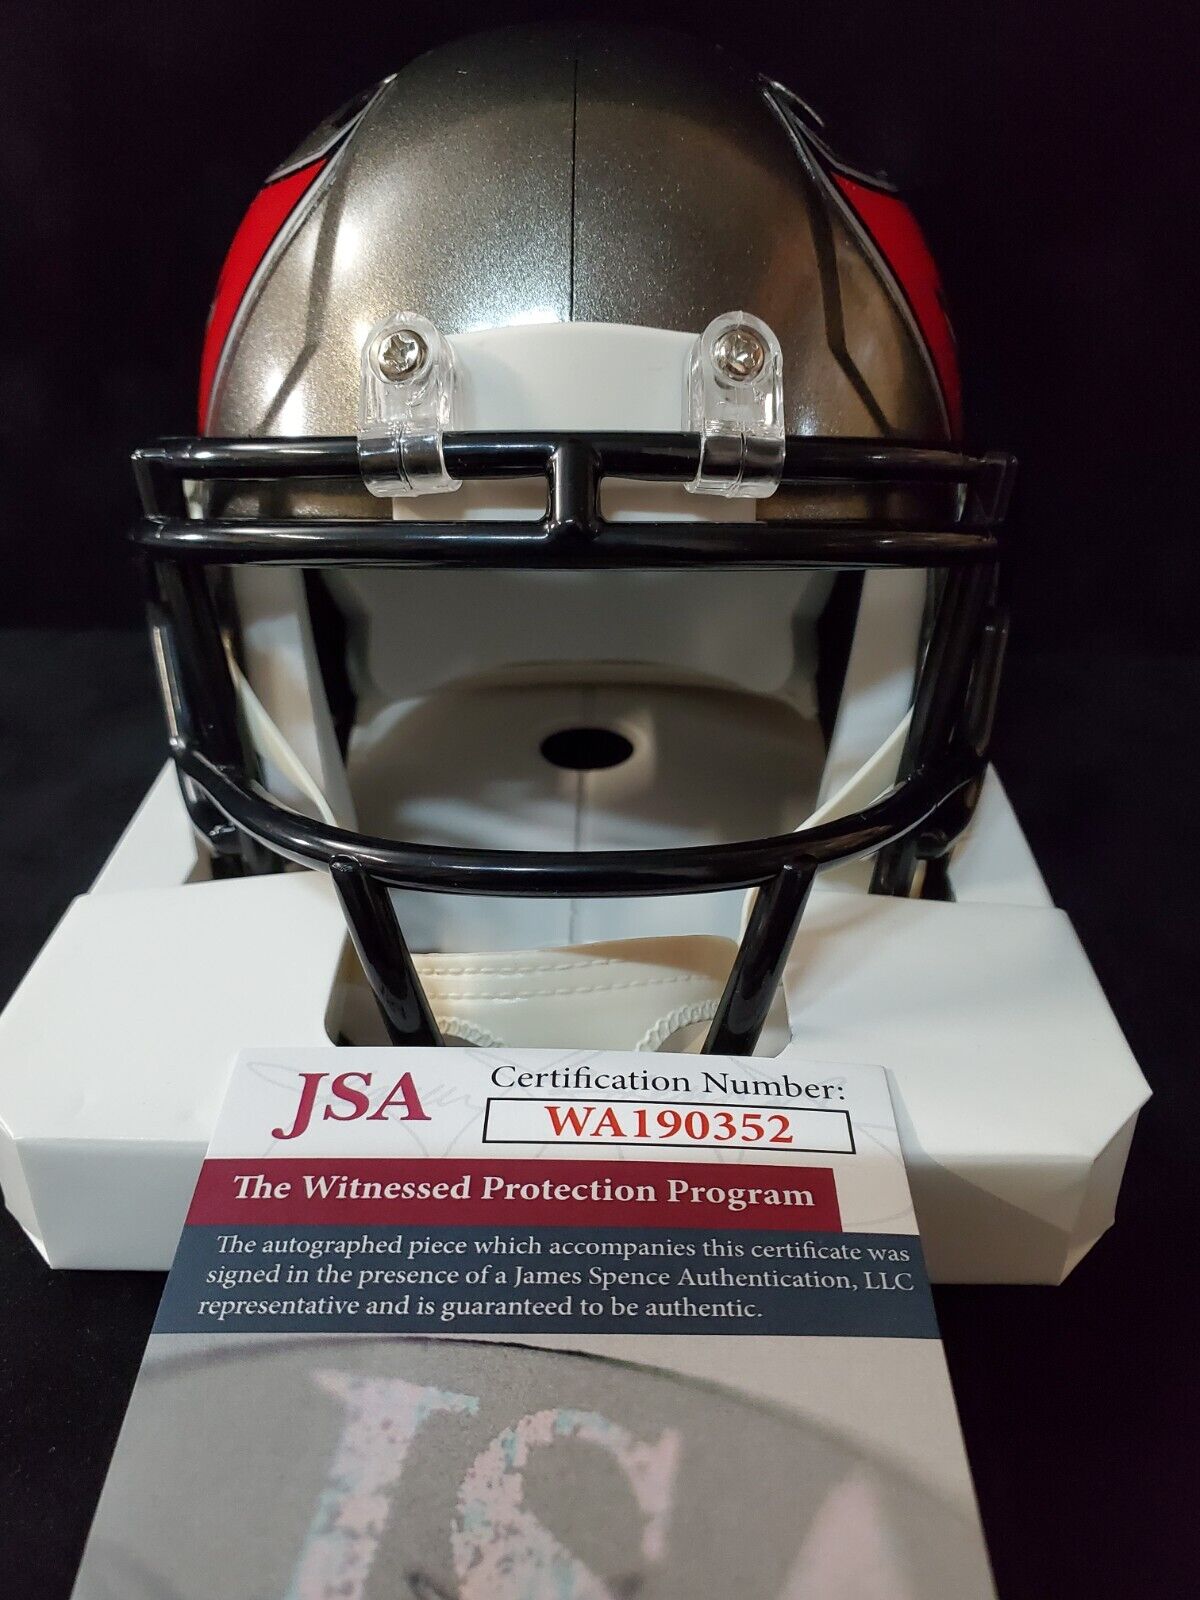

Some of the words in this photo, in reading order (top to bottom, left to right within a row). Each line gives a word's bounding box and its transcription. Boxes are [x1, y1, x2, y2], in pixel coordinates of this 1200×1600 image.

[491, 1065, 691, 1094] Certification
[702, 1071, 845, 1100] Number:
[271, 1072, 432, 1140] JSA
[544, 1105, 794, 1144] WA190352
[233, 1174, 292, 1200] The
[302, 1175, 471, 1200] Witnessed
[481, 1176, 657, 1202] Protection
[666, 1179, 815, 1212] Program
[217, 1234, 257, 1254] The
[262, 1235, 402, 1260] autographed
[408, 1237, 467, 1260] piece
[474, 1236, 542, 1255] which
[549, 1239, 696, 1261] accompanies
[702, 1239, 744, 1258] this
[751, 1241, 861, 1260] certificate
[866, 1248, 910, 1262] was
[205, 1264, 280, 1289] signed
[286, 1264, 309, 1283] in
[317, 1264, 353, 1284] the
[356, 1270, 459, 1290] presence
[465, 1264, 492, 1285] of
[495, 1271, 507, 1285] a
[513, 1266, 582, 1289] James
[588, 1267, 670, 1291] Spence
[677, 1268, 858, 1291] Authentication,
[863, 1271, 914, 1291] LLC
[197, 1296, 360, 1322] representative
[366, 1296, 410, 1316] and
[417, 1296, 435, 1316] is
[440, 1297, 572, 1322] guaranteed
[580, 1299, 604, 1317] to
[611, 1298, 639, 1317] be
[645, 1299, 763, 1318] authentic.
